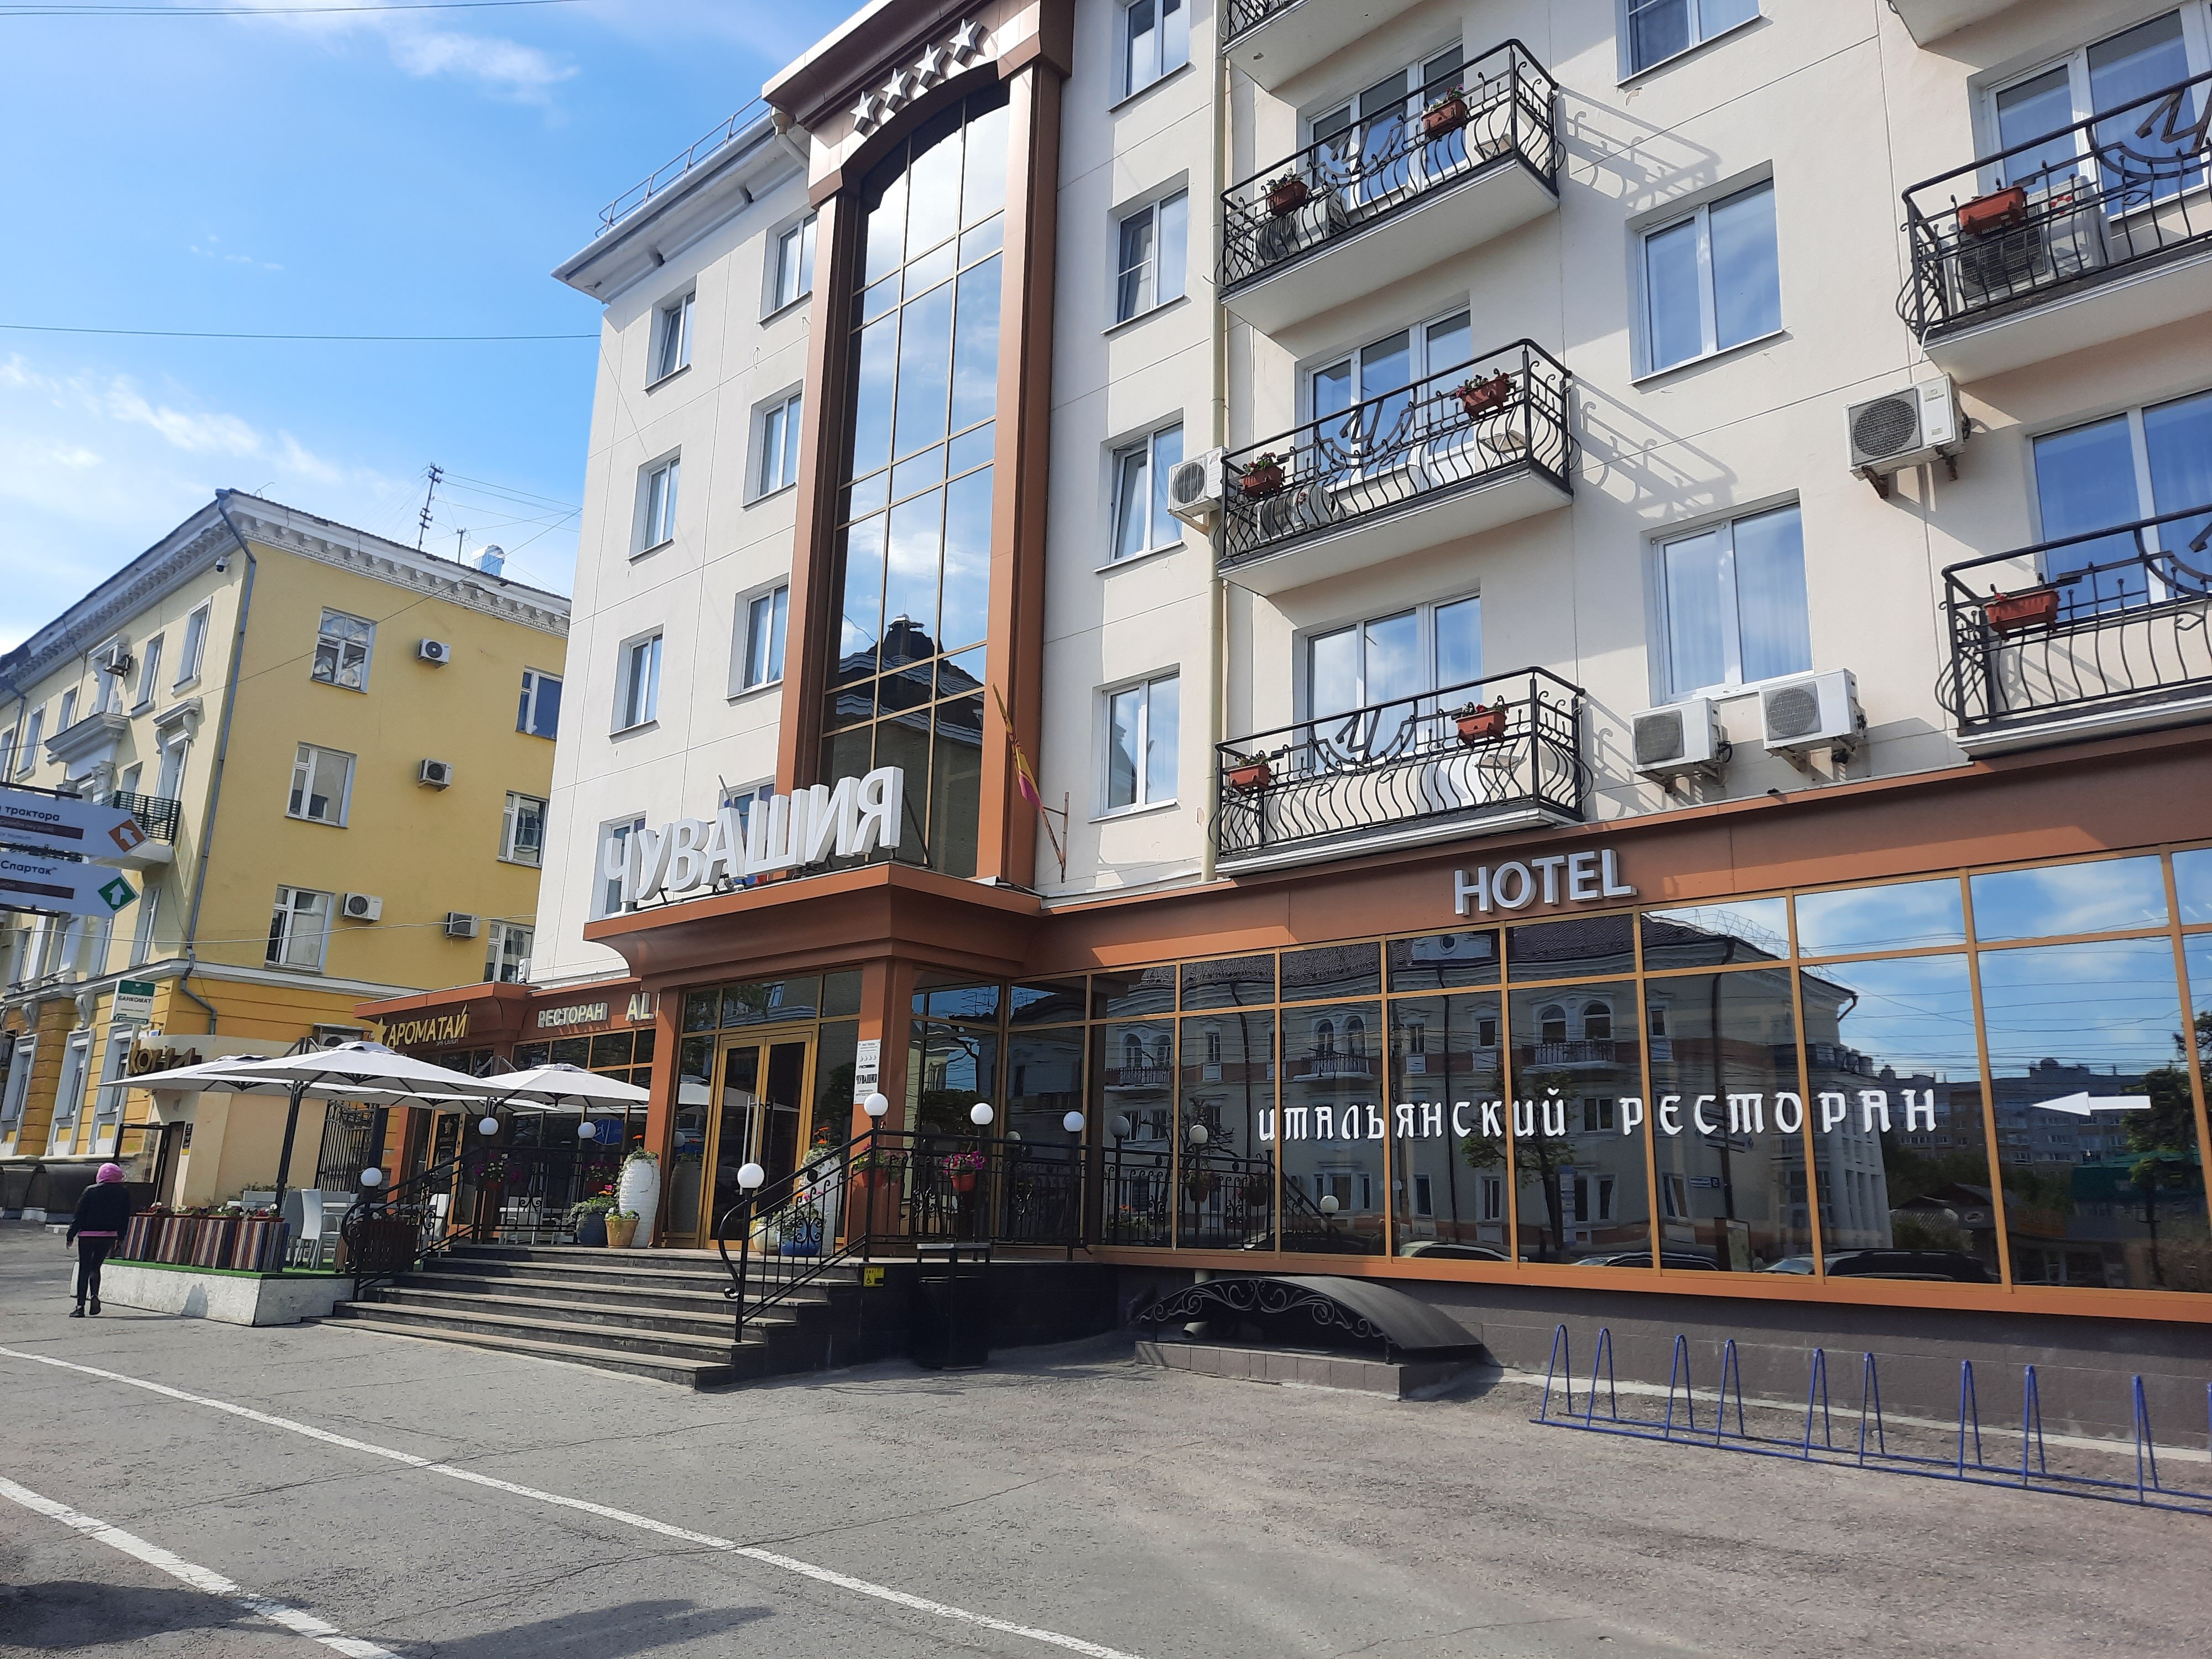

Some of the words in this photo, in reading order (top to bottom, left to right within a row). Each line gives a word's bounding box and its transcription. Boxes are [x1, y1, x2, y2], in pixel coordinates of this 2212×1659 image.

[5, 806, 60, 821] трактора
[603, 766, 904, 902] ЧУВАШИЯ
[1454, 848, 1637, 916] HOTEL
[387, 1003, 469, 1048] АРОМАТАЙ
[537, 1002, 608, 1028] РЕСТОРАН
[1618, 1089, 1936, 1136] РЕСТОРАН
